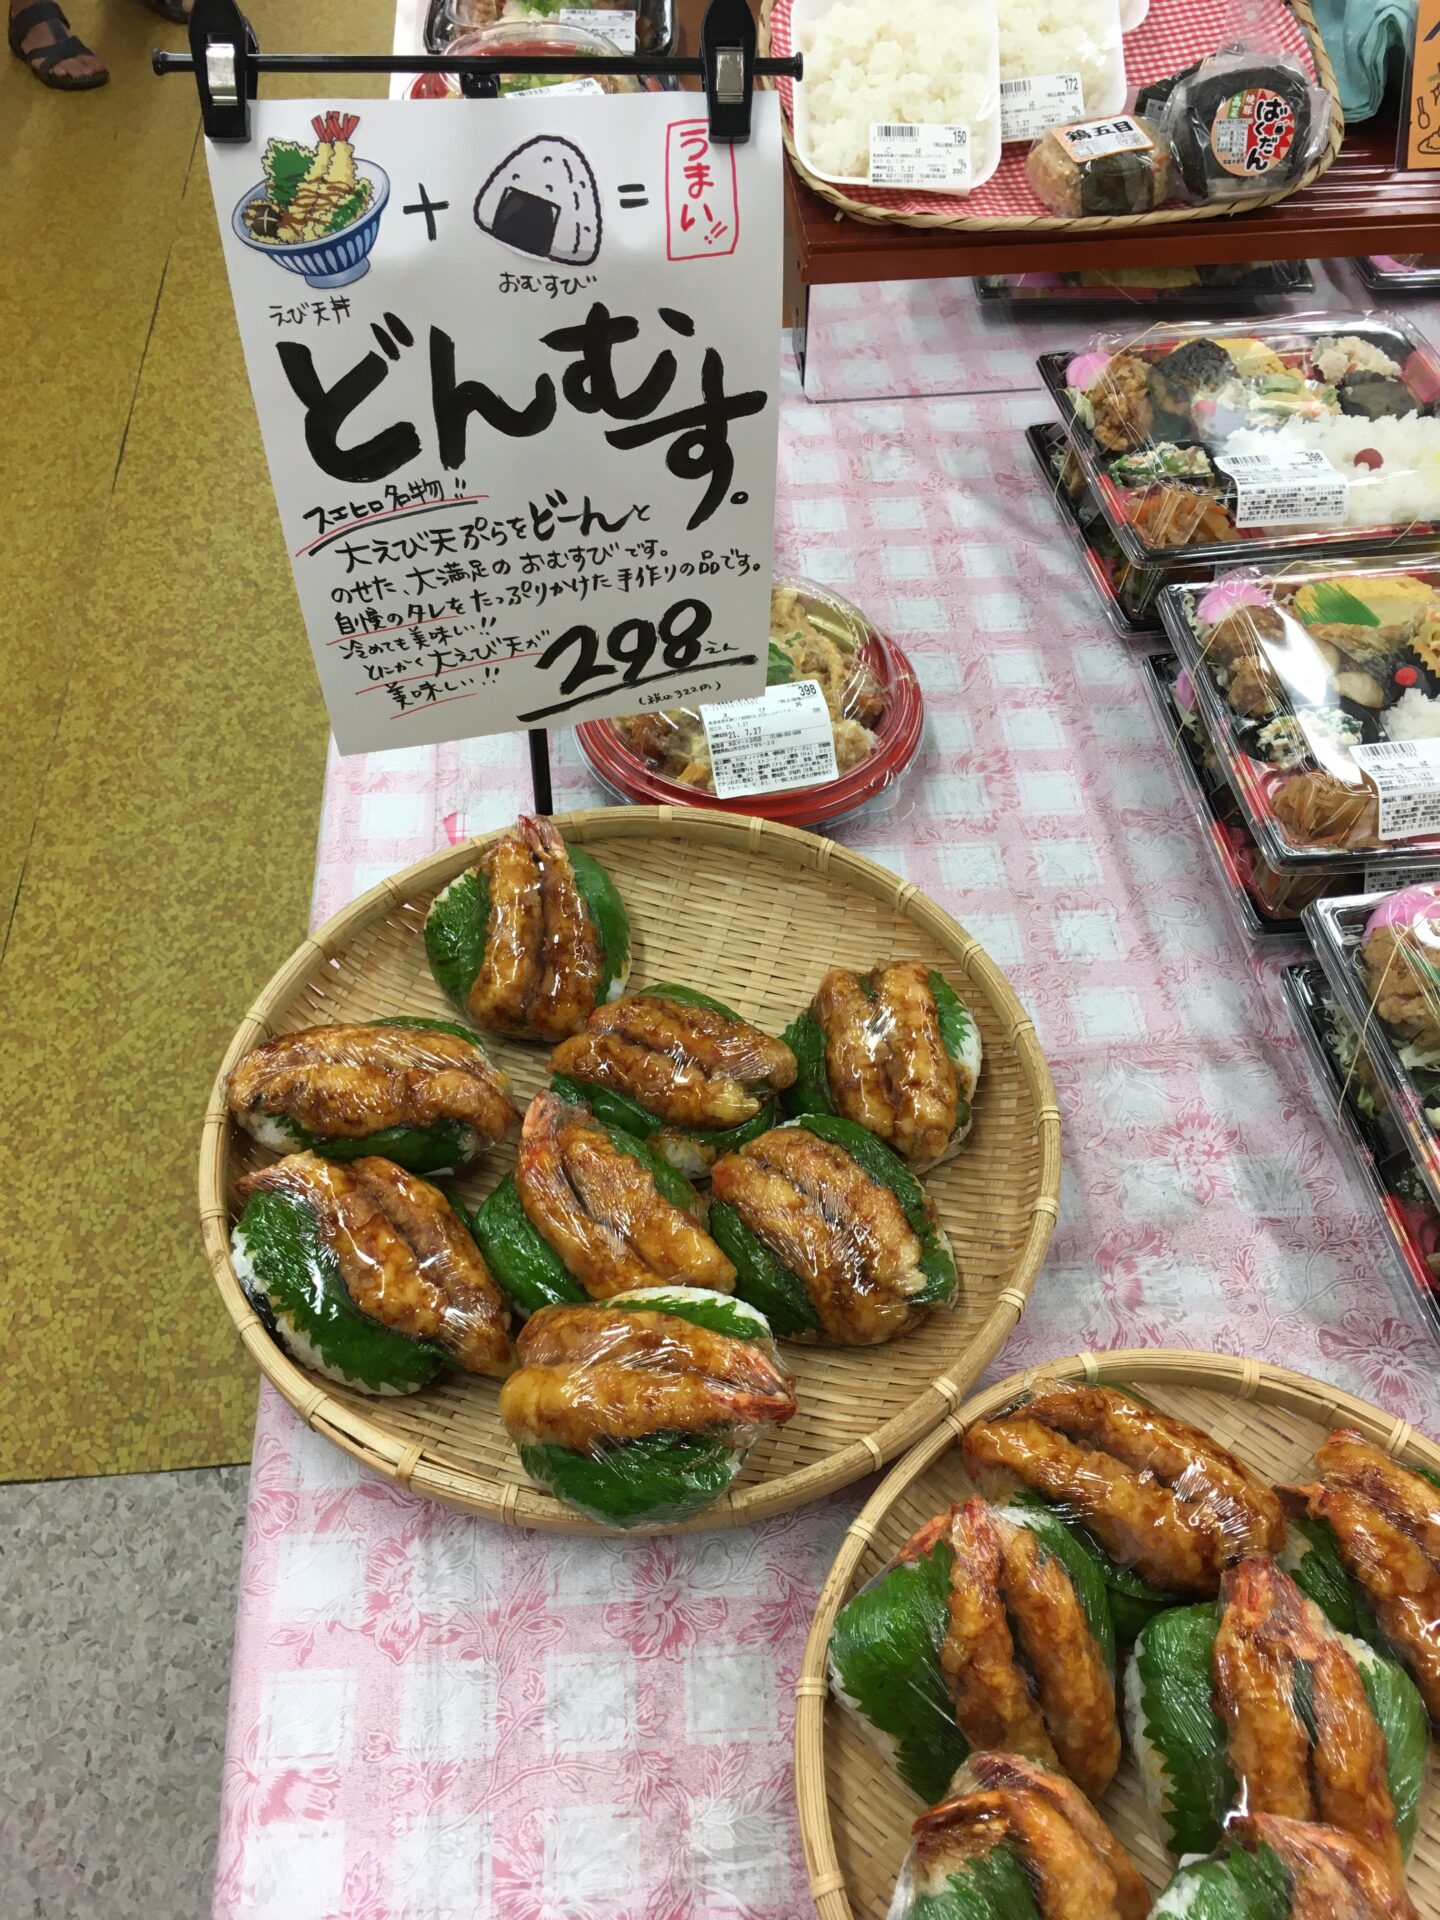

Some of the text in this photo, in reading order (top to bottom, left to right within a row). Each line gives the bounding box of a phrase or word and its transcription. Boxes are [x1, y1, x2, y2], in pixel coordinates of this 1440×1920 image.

[1064, 78, 1079, 91] 172
[953, 130, 967, 144] 150
[1064, 120, 1134, 143] 鶏五目
[1245, 98, 1289, 171] ばくだん
[498, 271, 598, 299] おむすび
[268, 295, 351, 327] えび天丼
[799, 683, 817, 697] 398
